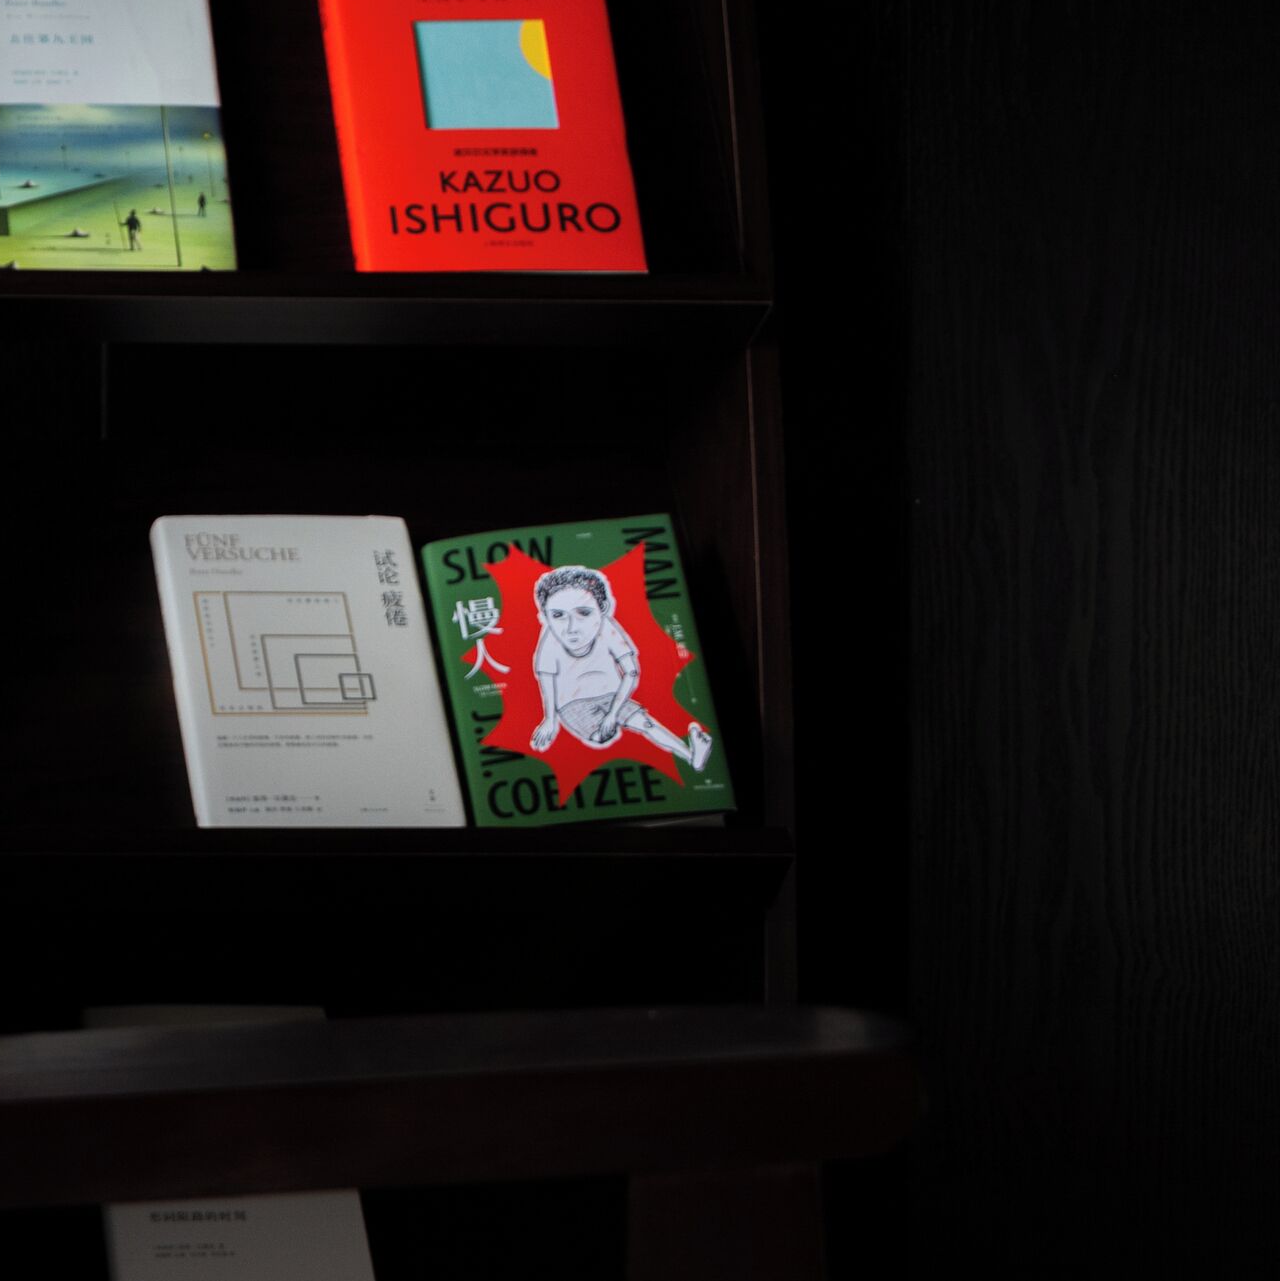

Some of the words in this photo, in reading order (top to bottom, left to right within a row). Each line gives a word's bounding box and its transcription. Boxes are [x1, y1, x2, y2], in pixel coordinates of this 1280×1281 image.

[440, 169, 560, 193] KAZUO
[390, 202, 621, 235] ISHIGURO
[184, 531, 240, 547] FÜNF
[185, 546, 303, 561] VERSUCHE
[452, 597, 511, 680] 慢人
